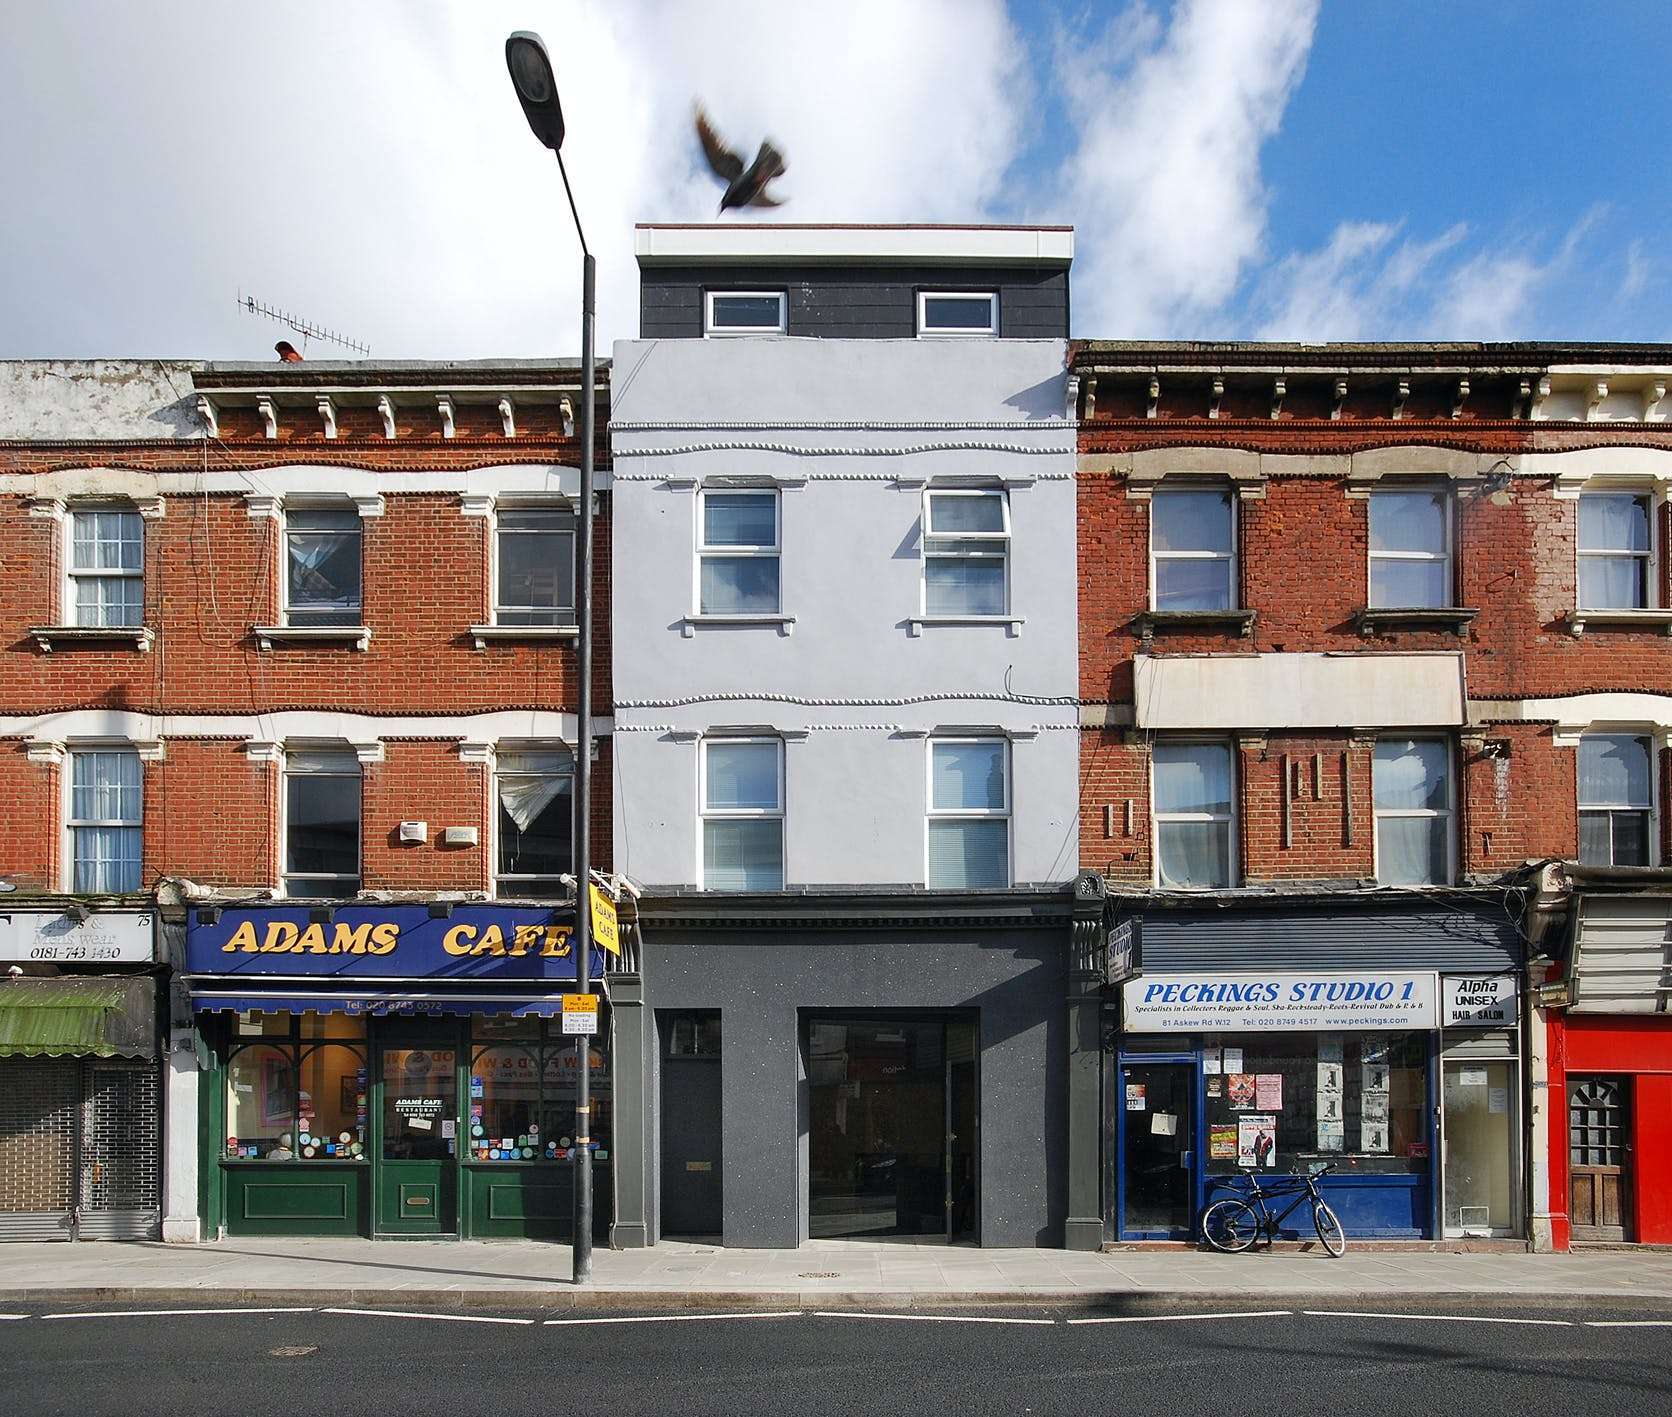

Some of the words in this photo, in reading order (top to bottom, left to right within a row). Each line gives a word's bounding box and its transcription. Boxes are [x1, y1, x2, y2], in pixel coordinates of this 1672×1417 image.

[137, 915, 151, 927] 75
[221, 920, 401, 955] ADAMS
[442, 923, 574, 957] CAFE
[30, 947, 87, 959] 0181-743
[1143, 982, 1281, 1003] PECKINGS
[1289, 981, 1394, 1002] STUDIO
[1400, 981, 1414, 1001] 1
[1457, 980, 1498, 994] Alpha
[366, 1000, 385, 1010] 020
[417, 1002, 442, 1010] 0572
[1455, 995, 1499, 1006] UNISEX
[1135, 1005, 1172, 1013] Specialists
[1218, 1005, 1244, 1013] Reggae
[1452, 1010, 1470, 1020] HAIR
[1477, 1010, 1504, 1020] SALON
[1242, 1018, 1255, 1026] Tel:
[1325, 1017, 1408, 1026] www.peckings.com
